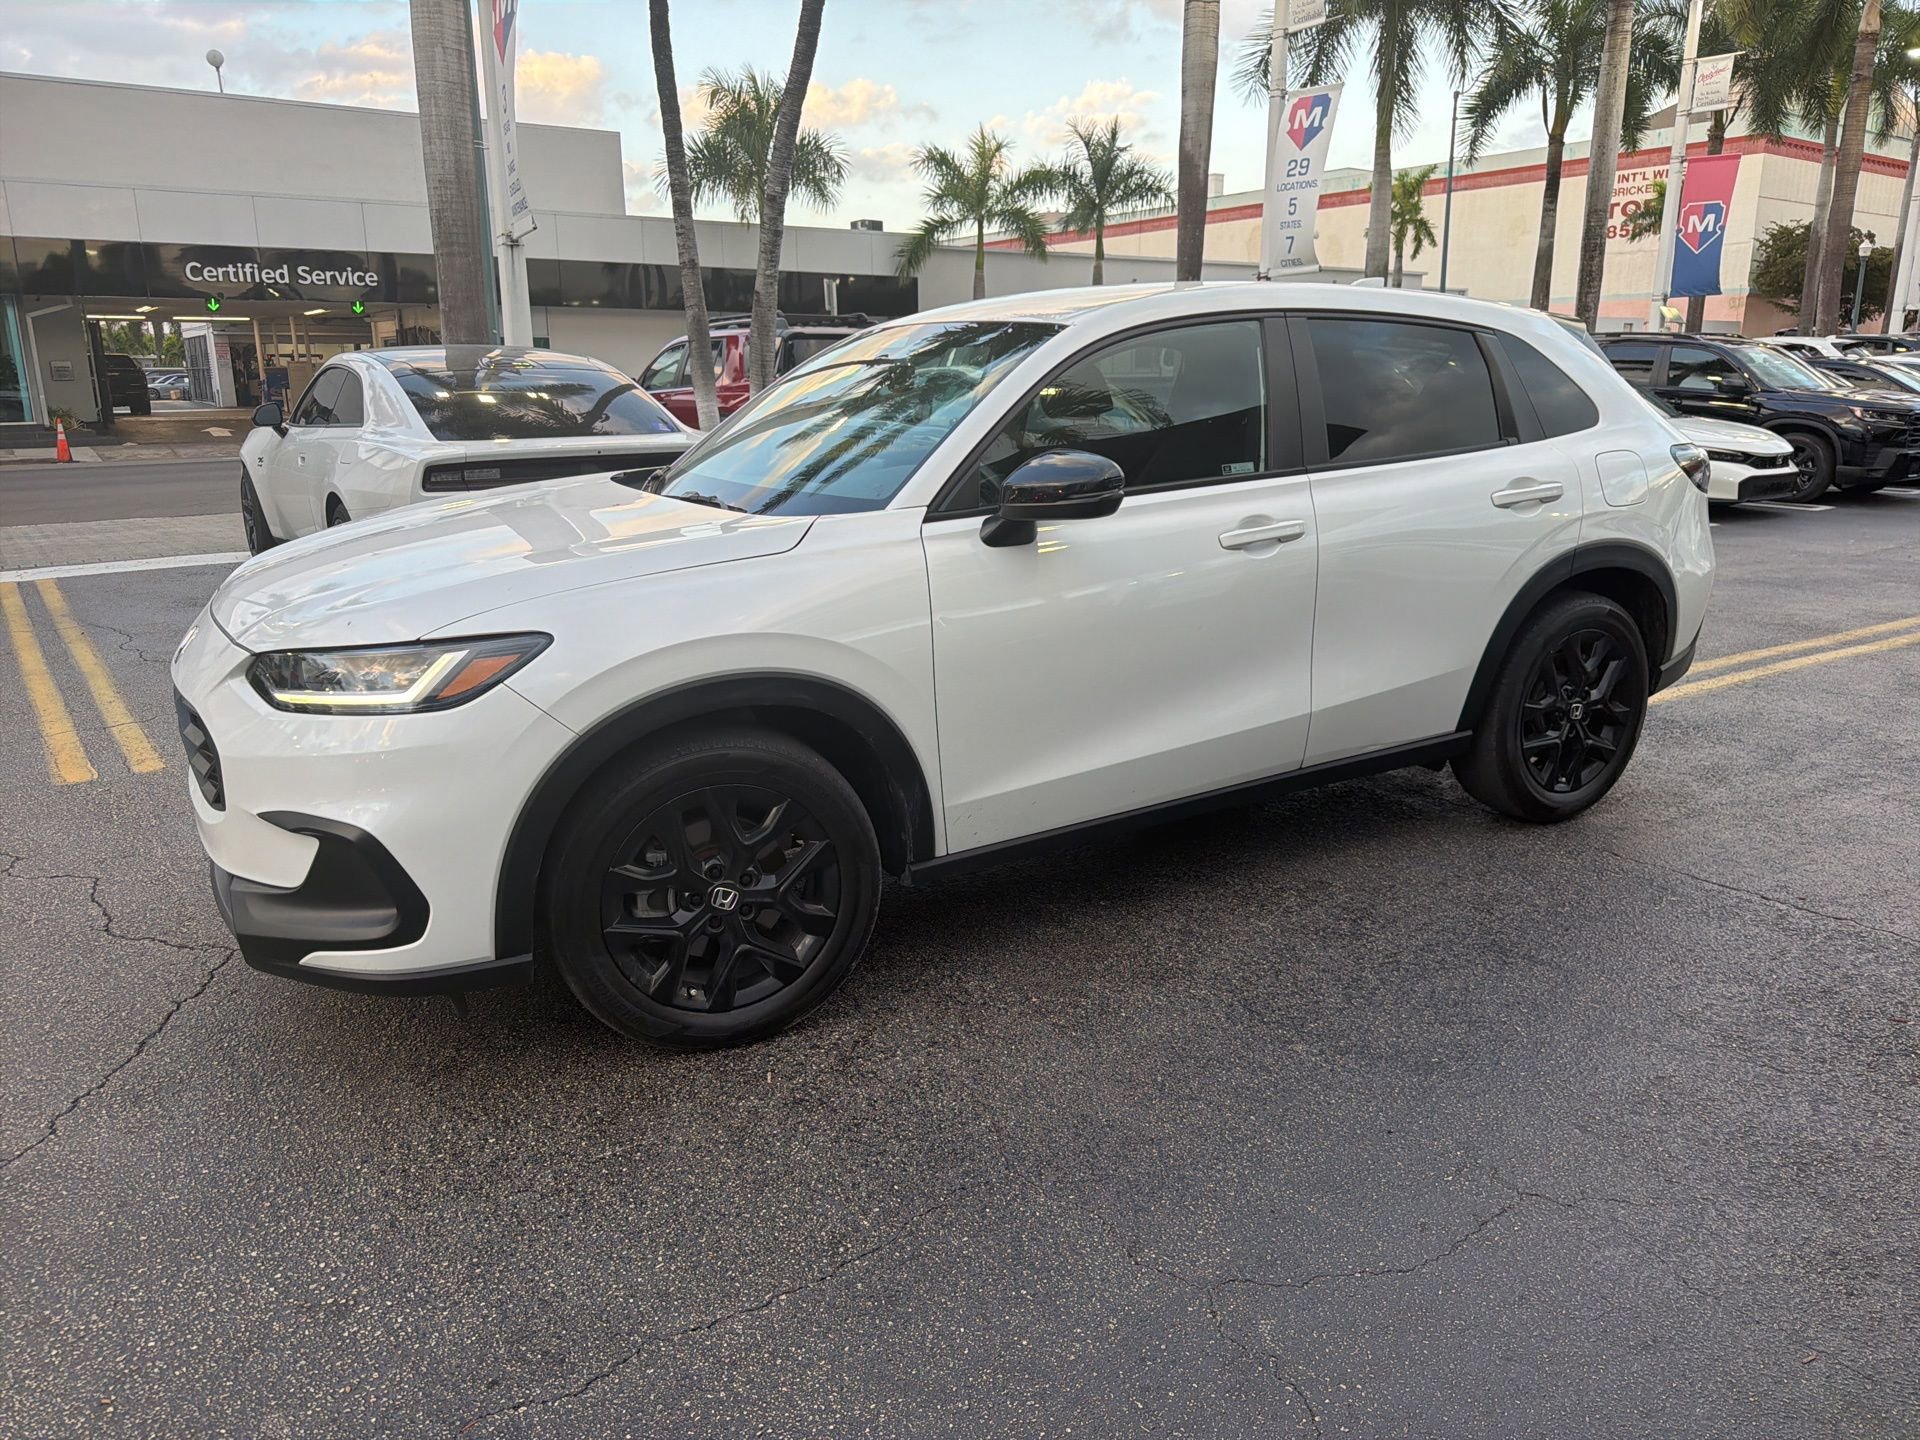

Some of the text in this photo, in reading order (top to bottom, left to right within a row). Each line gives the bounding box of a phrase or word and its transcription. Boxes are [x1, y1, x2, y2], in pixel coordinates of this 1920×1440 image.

[1293, 106, 1322, 130] M
[1286, 157, 1311, 178] 29
[1276, 179, 1319, 193] LOCATIONS.
[1617, 171, 1650, 184] INT'L
[1288, 197, 1298, 216] 5
[1687, 213, 1716, 233] M
[1285, 236, 1295, 255] 7
[185, 261, 379, 287] Certified Service
